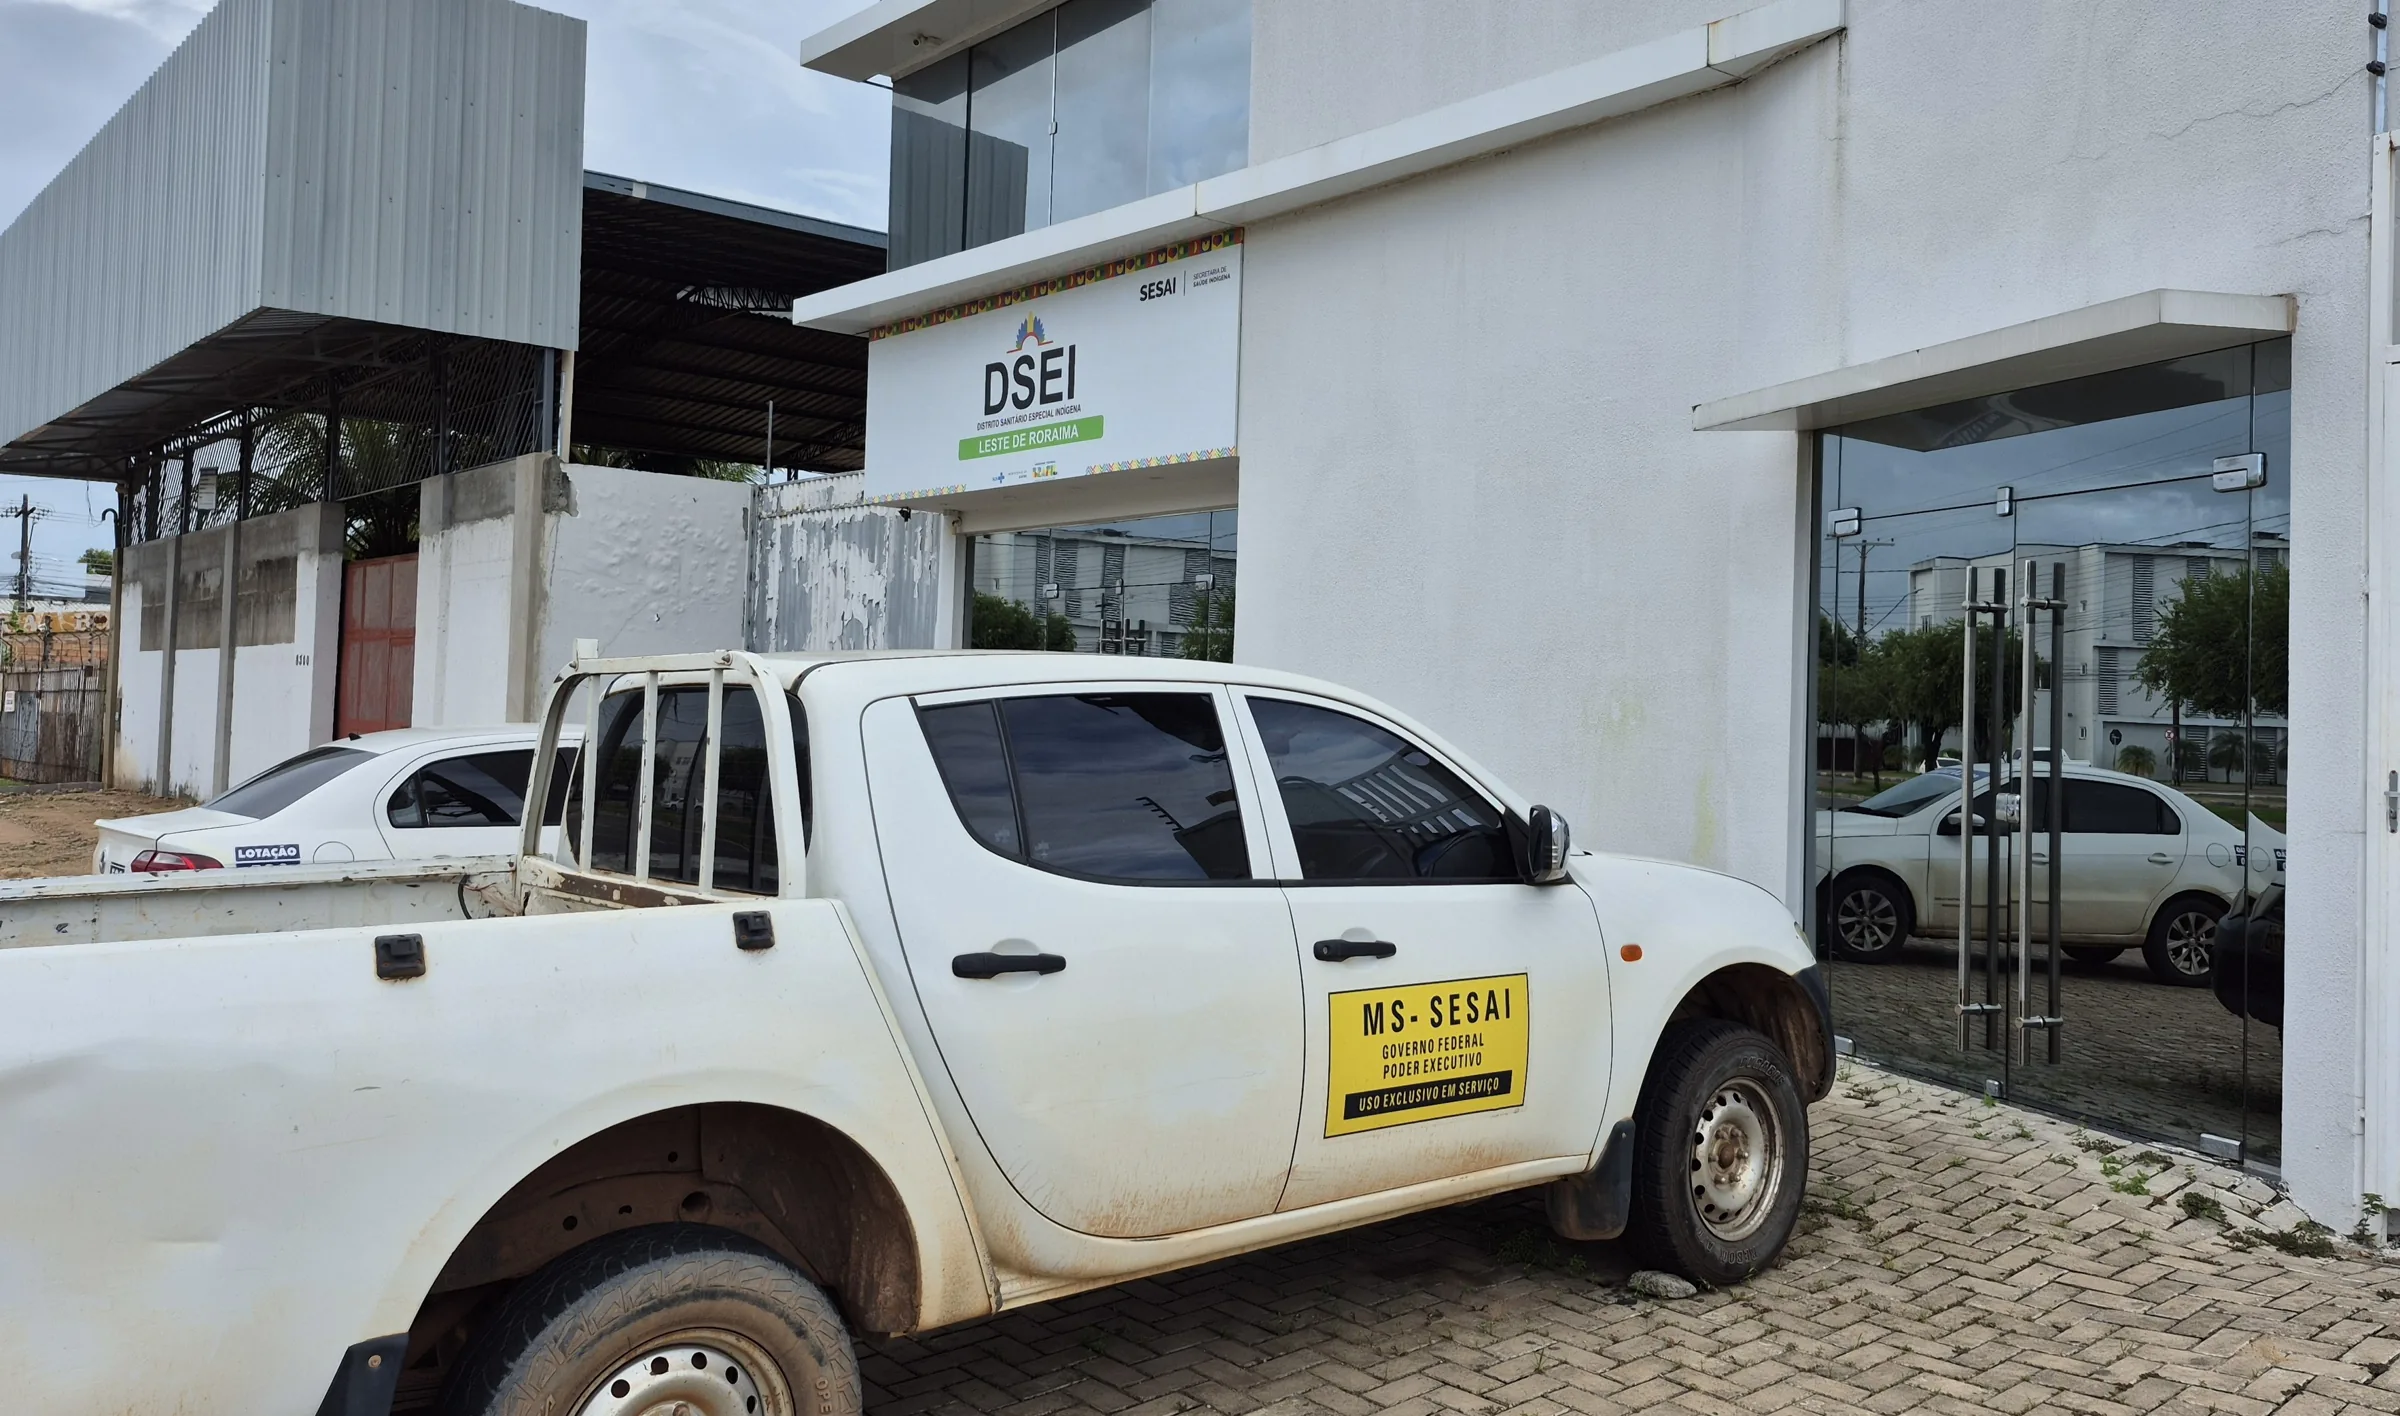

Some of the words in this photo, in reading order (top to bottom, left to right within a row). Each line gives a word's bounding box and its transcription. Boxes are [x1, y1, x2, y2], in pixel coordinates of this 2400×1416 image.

[1139, 276, 1177, 302] SESAI
[984, 344, 1076, 416] DSEI
[976, 419, 1000, 431] DISTRITO
[1000, 413, 1028, 427] SANITÁRIO
[1028, 410, 1054, 422] ESPECIAL
[1054, 403, 1082, 416] INDÍGENA
[979, 436, 1010, 454] LESTE
[1012, 433, 1027, 448] DE
[1029, 424, 1079, 446] RORAIMA
[238, 844, 297, 860] LOTAÇÃO
[1363, 1000, 1418, 1036] MS-
[1430, 988, 1511, 1028] SESAI
[1382, 1038, 1435, 1060] GOVERNO
[1438, 1032, 1485, 1053] FEDERAL
[1383, 1061, 1420, 1080] PODER
[1423, 1051, 1482, 1074] EXECUTIVO
[1358, 1095, 1380, 1112] USO
[1383, 1086, 1439, 1108] EXCLUSIVO
[1441, 1083, 1457, 1099] EM
[1458, 1076, 1499, 1096] SERVIÇO
